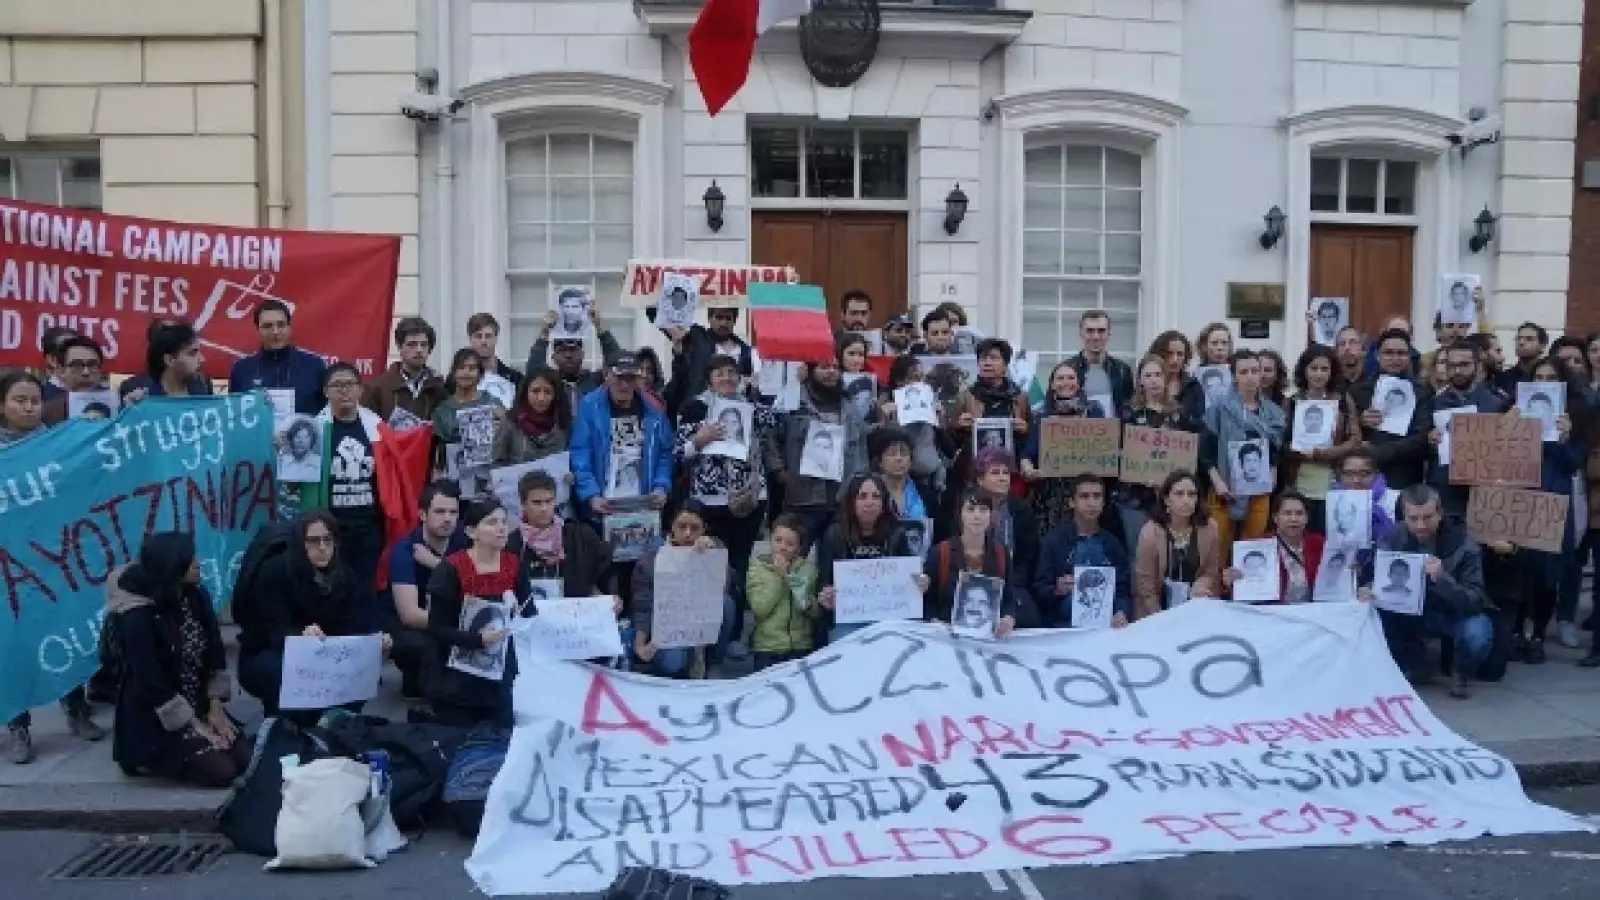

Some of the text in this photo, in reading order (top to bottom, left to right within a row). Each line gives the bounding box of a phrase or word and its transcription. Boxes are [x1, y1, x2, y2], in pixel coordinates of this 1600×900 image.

[122, 225, 282, 271] CAMPAIGN
[114, 271, 190, 316] FEES
[36, 312, 120, 360] CTS
[543, 840, 713, 878] AND
[727, 827, 989, 877] KILLED
[1001, 813, 1113, 860] 6
